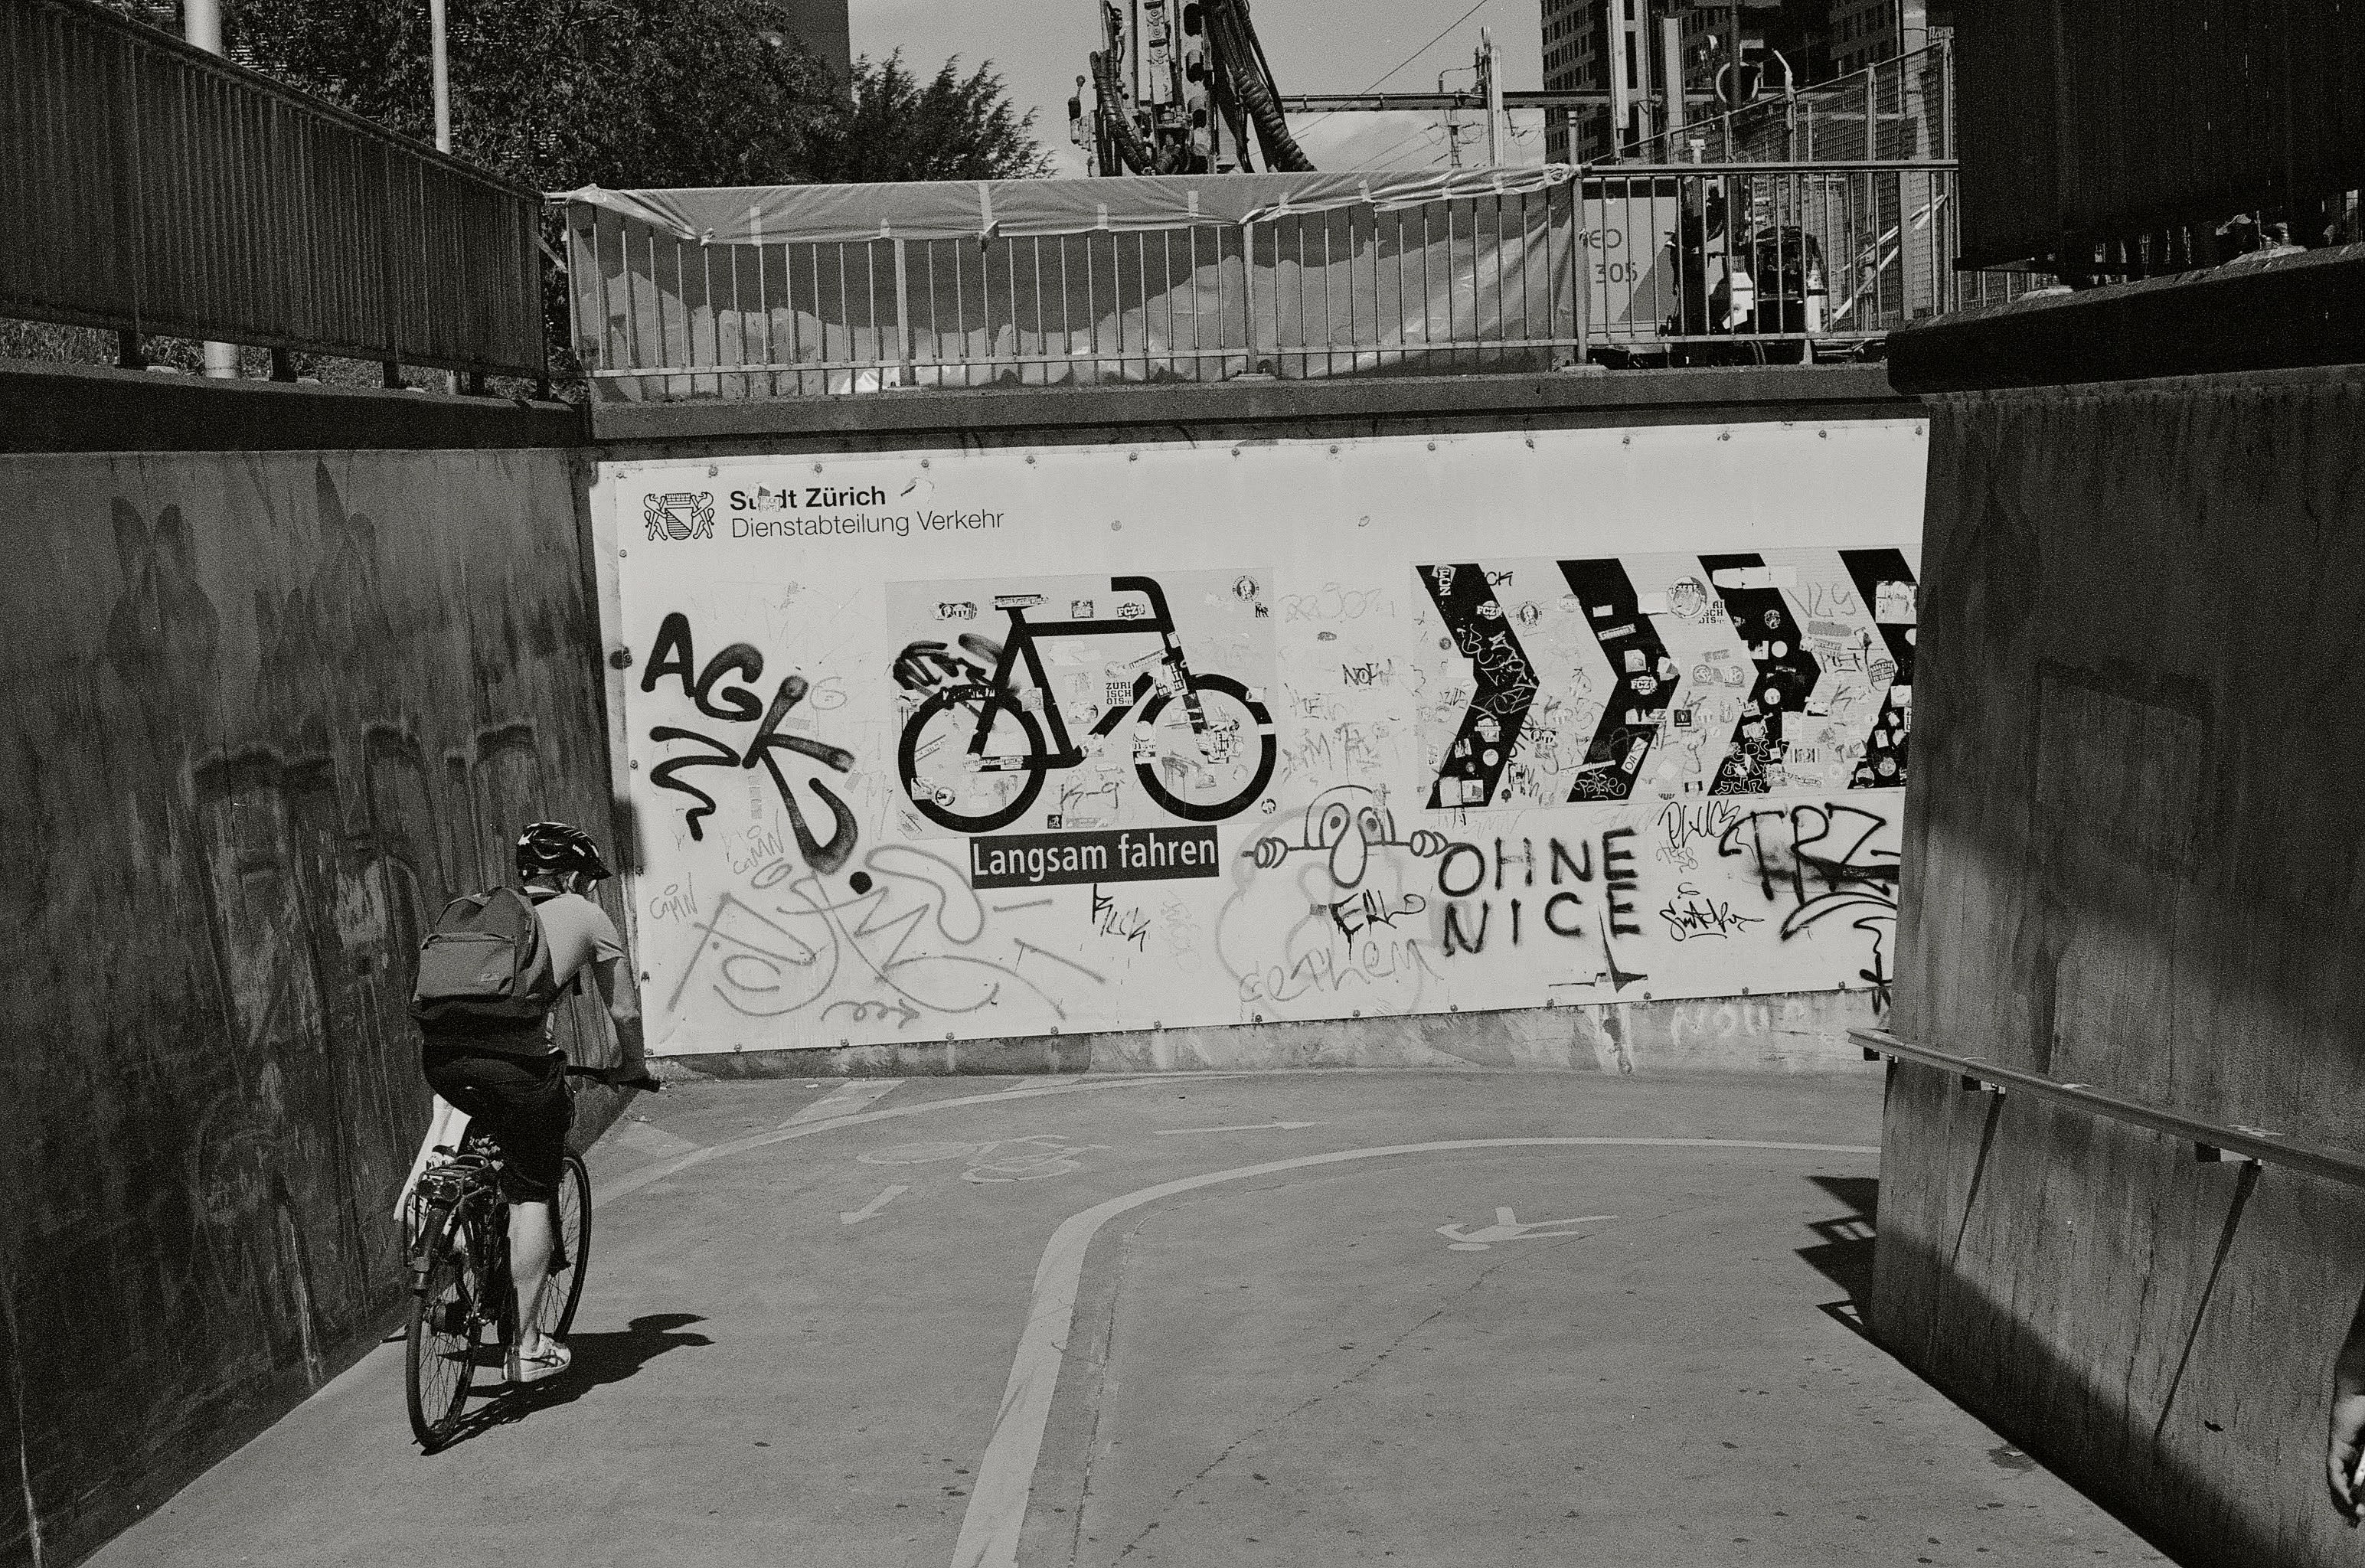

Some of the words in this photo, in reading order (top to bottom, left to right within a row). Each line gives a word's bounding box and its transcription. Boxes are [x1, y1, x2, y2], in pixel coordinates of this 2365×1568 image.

[805, 485, 886, 508] Zürich
[732, 512, 910, 538] Dienstabteilung
[916, 508, 1005, 531] Verkehr
[973, 842, 1107, 882] Langsam
[1118, 833, 1216, 869] fahren
[1438, 827, 1638, 897] OHNE
[1443, 881, 1641, 957] NICE
